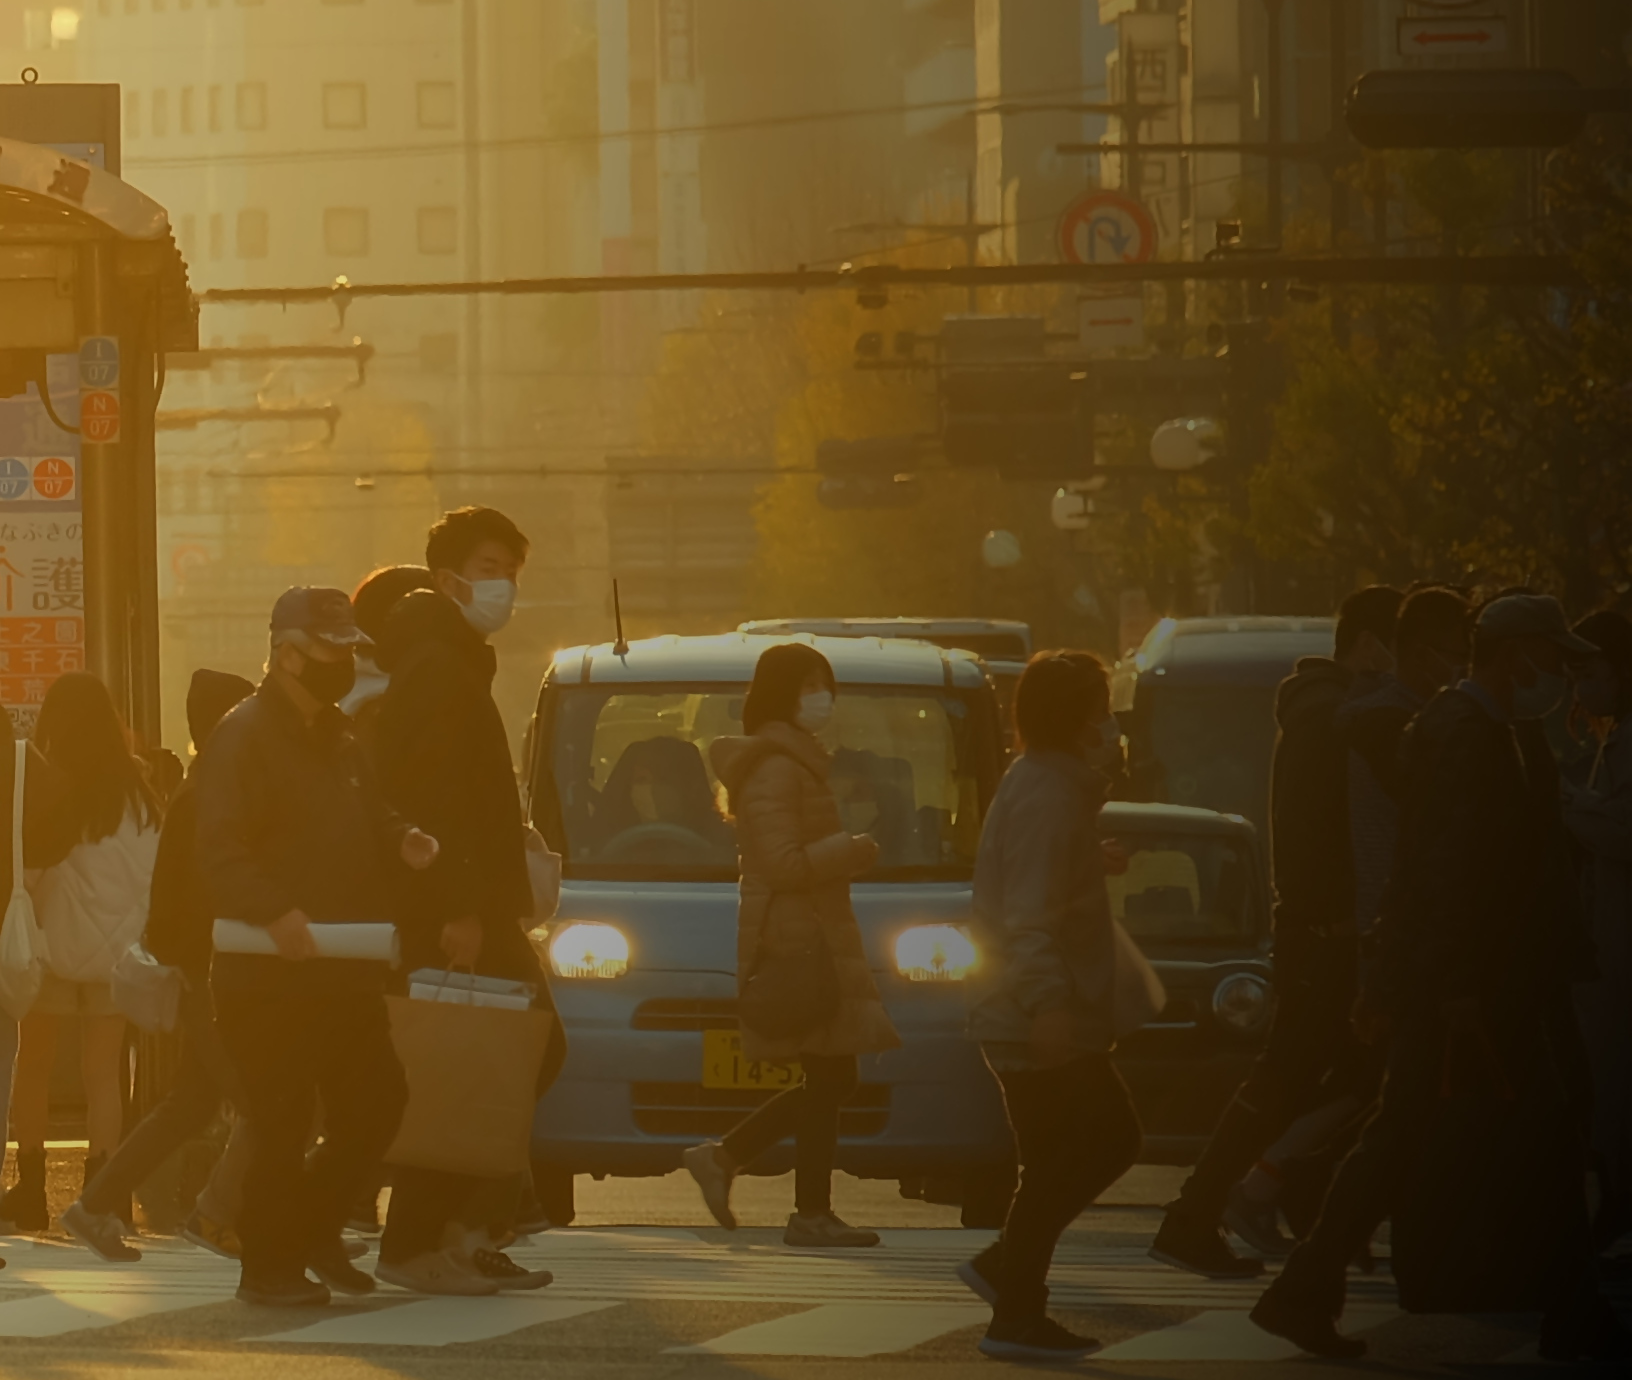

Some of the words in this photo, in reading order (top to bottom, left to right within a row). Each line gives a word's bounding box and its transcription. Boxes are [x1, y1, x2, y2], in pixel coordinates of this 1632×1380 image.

[88, 365, 110, 381] 07
[93, 396, 107, 411] N
[89, 419, 111, 436] 07
[47, 461, 59, 475] N
[0, 481, 18, 495] 07
[44, 480, 64, 495] 07
